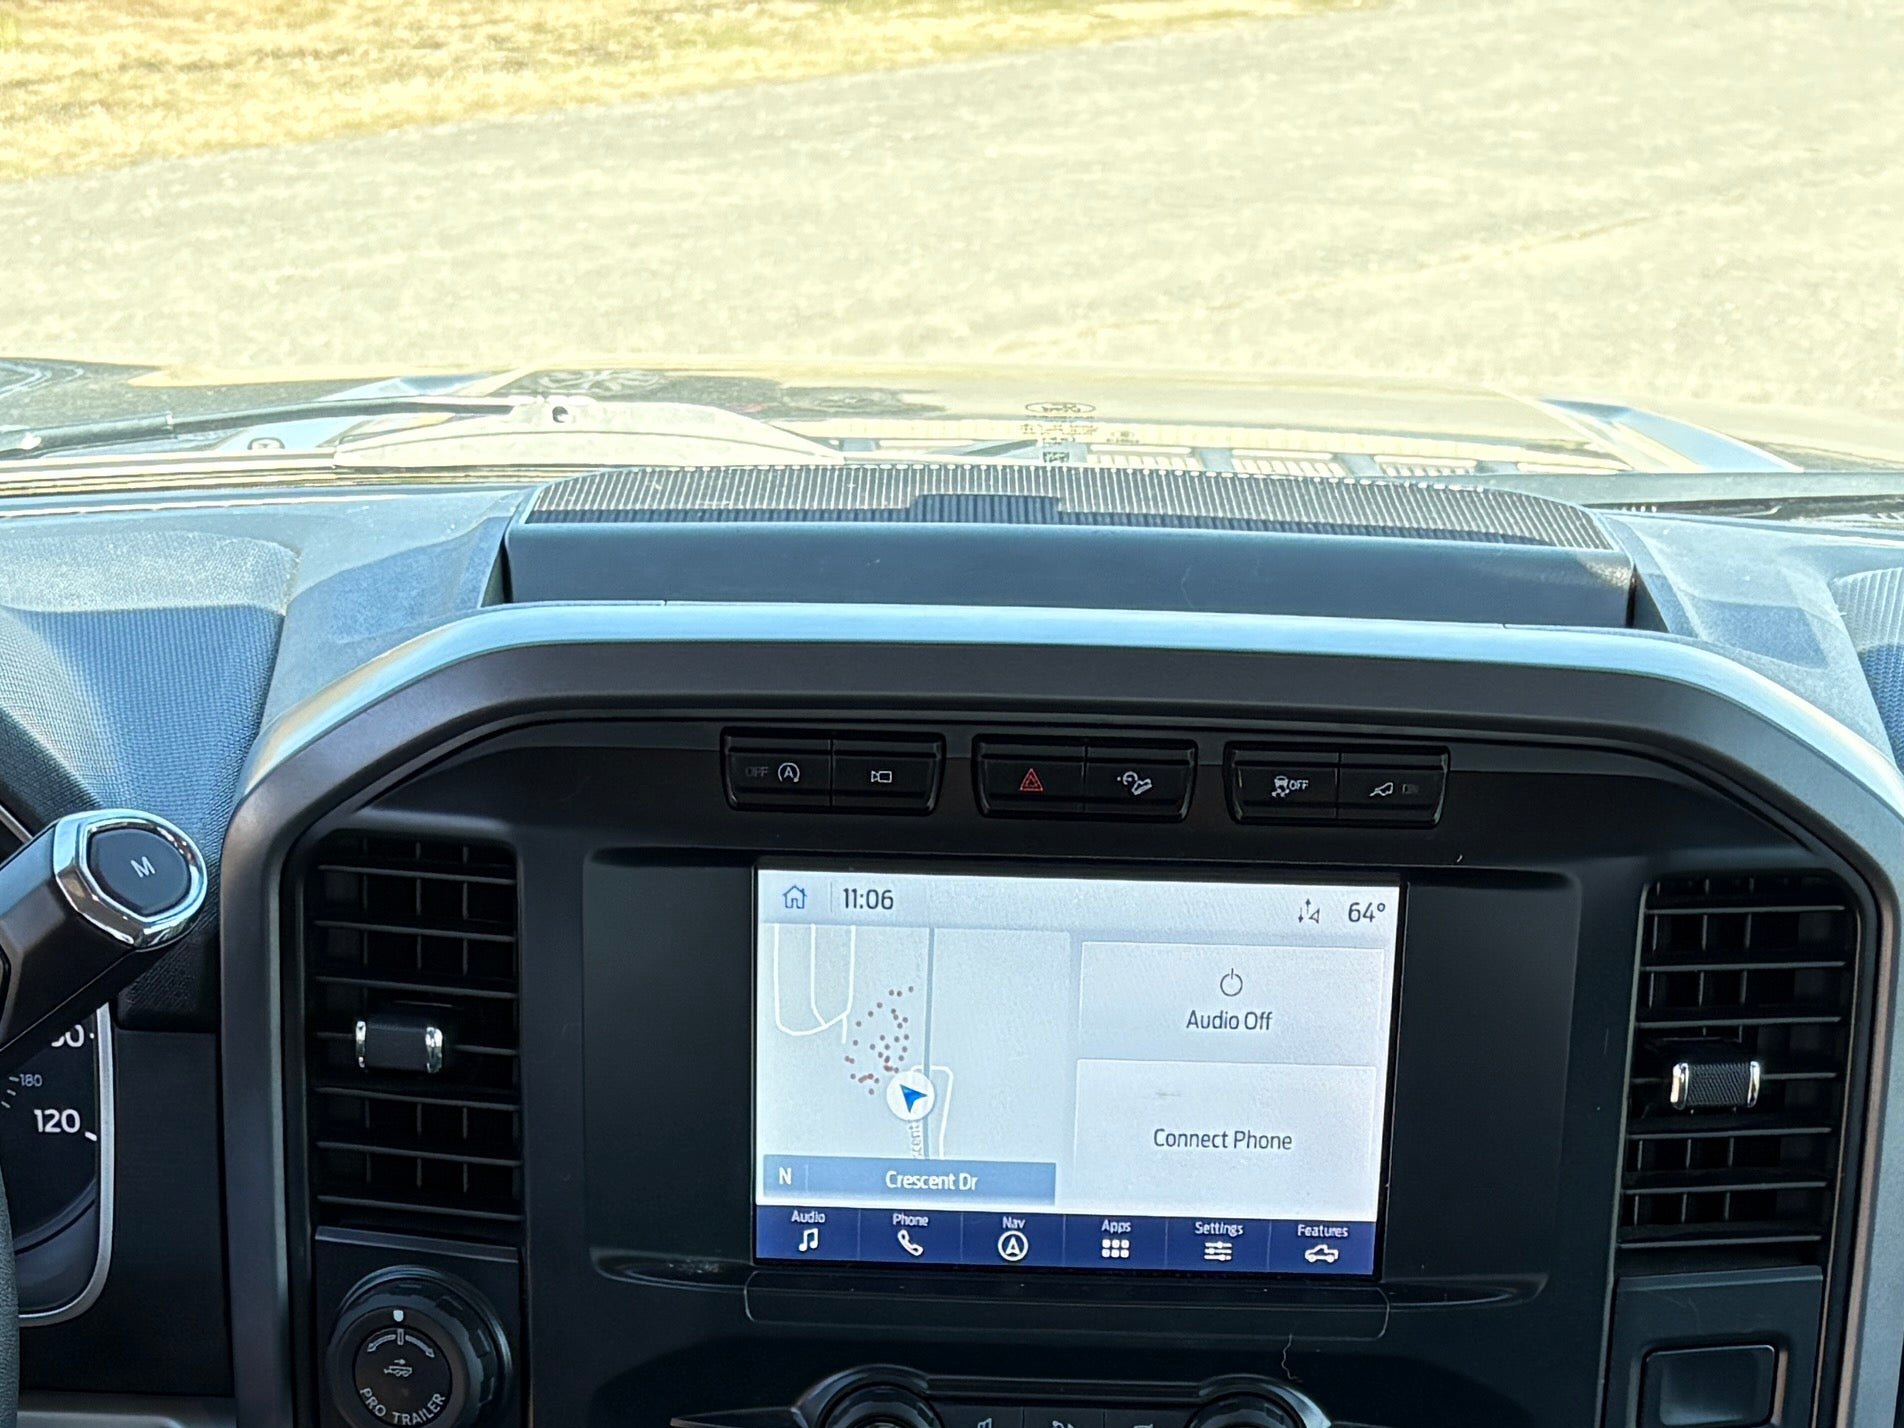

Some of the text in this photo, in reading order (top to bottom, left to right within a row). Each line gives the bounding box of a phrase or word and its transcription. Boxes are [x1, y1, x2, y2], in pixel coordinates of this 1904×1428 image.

[1288, 779, 1309, 791] OFF
[130, 855, 156, 878] M
[842, 887, 895, 912] 11:06
[1347, 901, 1388, 925] 64°
[1186, 1009, 1274, 1031] Audio Off
[18, 1073, 44, 1088] 180
[33, 1108, 82, 1134] 120
[1153, 1127, 1294, 1151] Connect Phone
[778, 1166, 793, 1186] N
[885, 1170, 979, 1191] Crescent Dr
[791, 1209, 826, 1224] Audio
[892, 1212, 930, 1228] Phone
[1002, 1215, 1026, 1229] Nav
[1101, 1218, 1132, 1234] Apps
[1195, 1220, 1244, 1237] Settings
[1297, 1223, 1349, 1239] Features
[359, 1387, 447, 1426] PRO TRAILER
